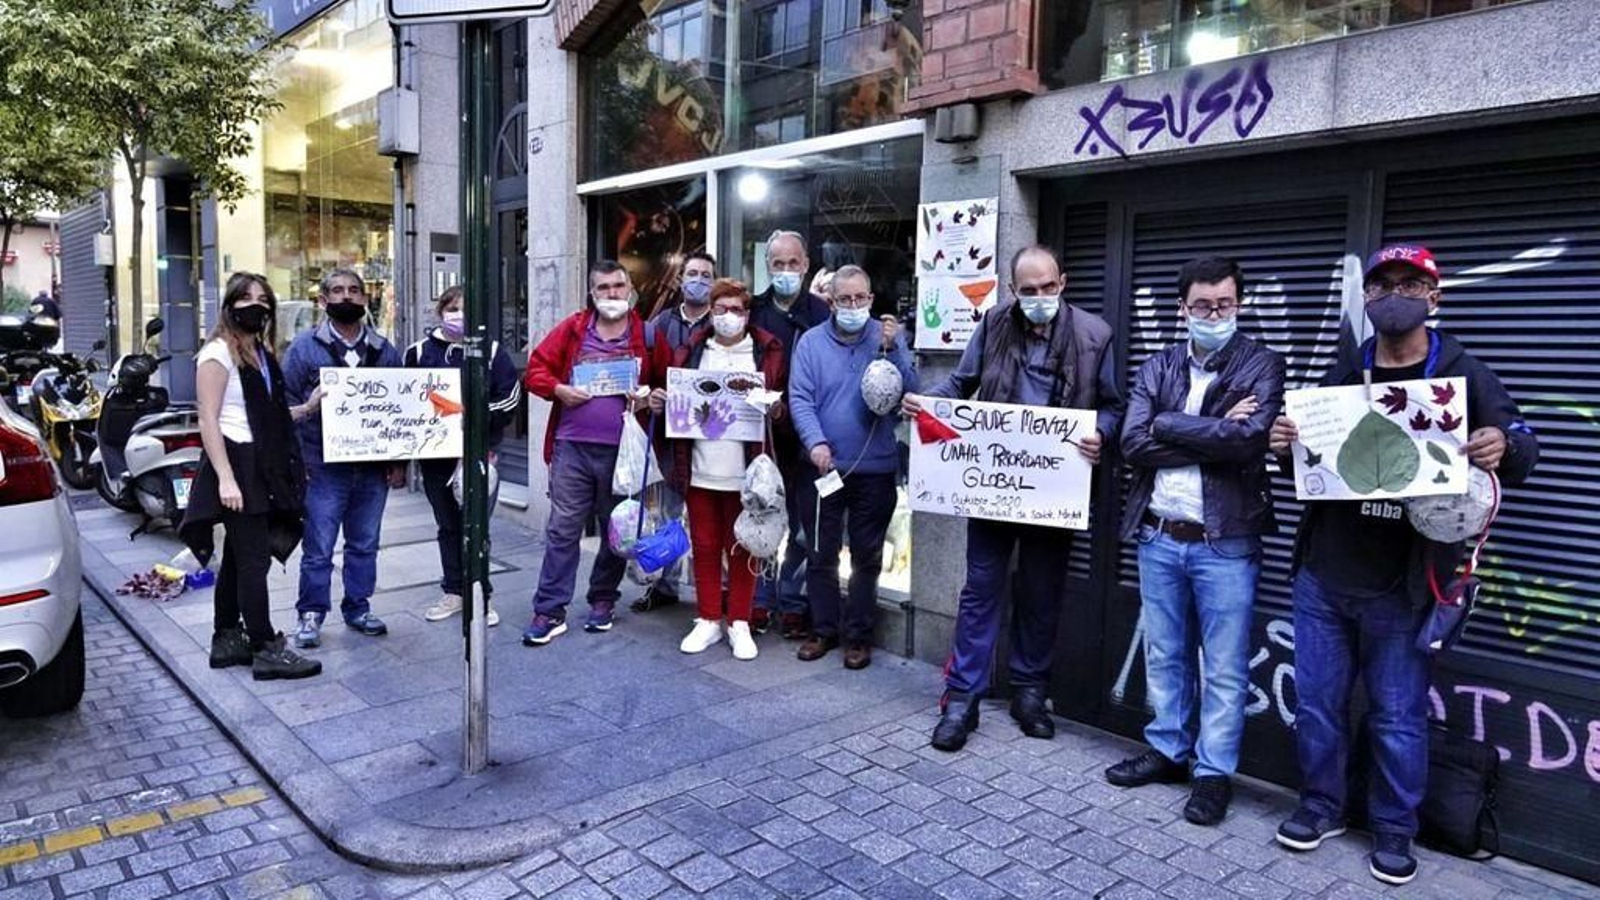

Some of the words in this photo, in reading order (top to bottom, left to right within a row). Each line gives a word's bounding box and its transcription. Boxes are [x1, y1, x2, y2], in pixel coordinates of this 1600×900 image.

[939, 440, 980, 463] UNHA
[962, 466, 1036, 491] GLOBAL
[1361, 502, 1402, 519] cuba
